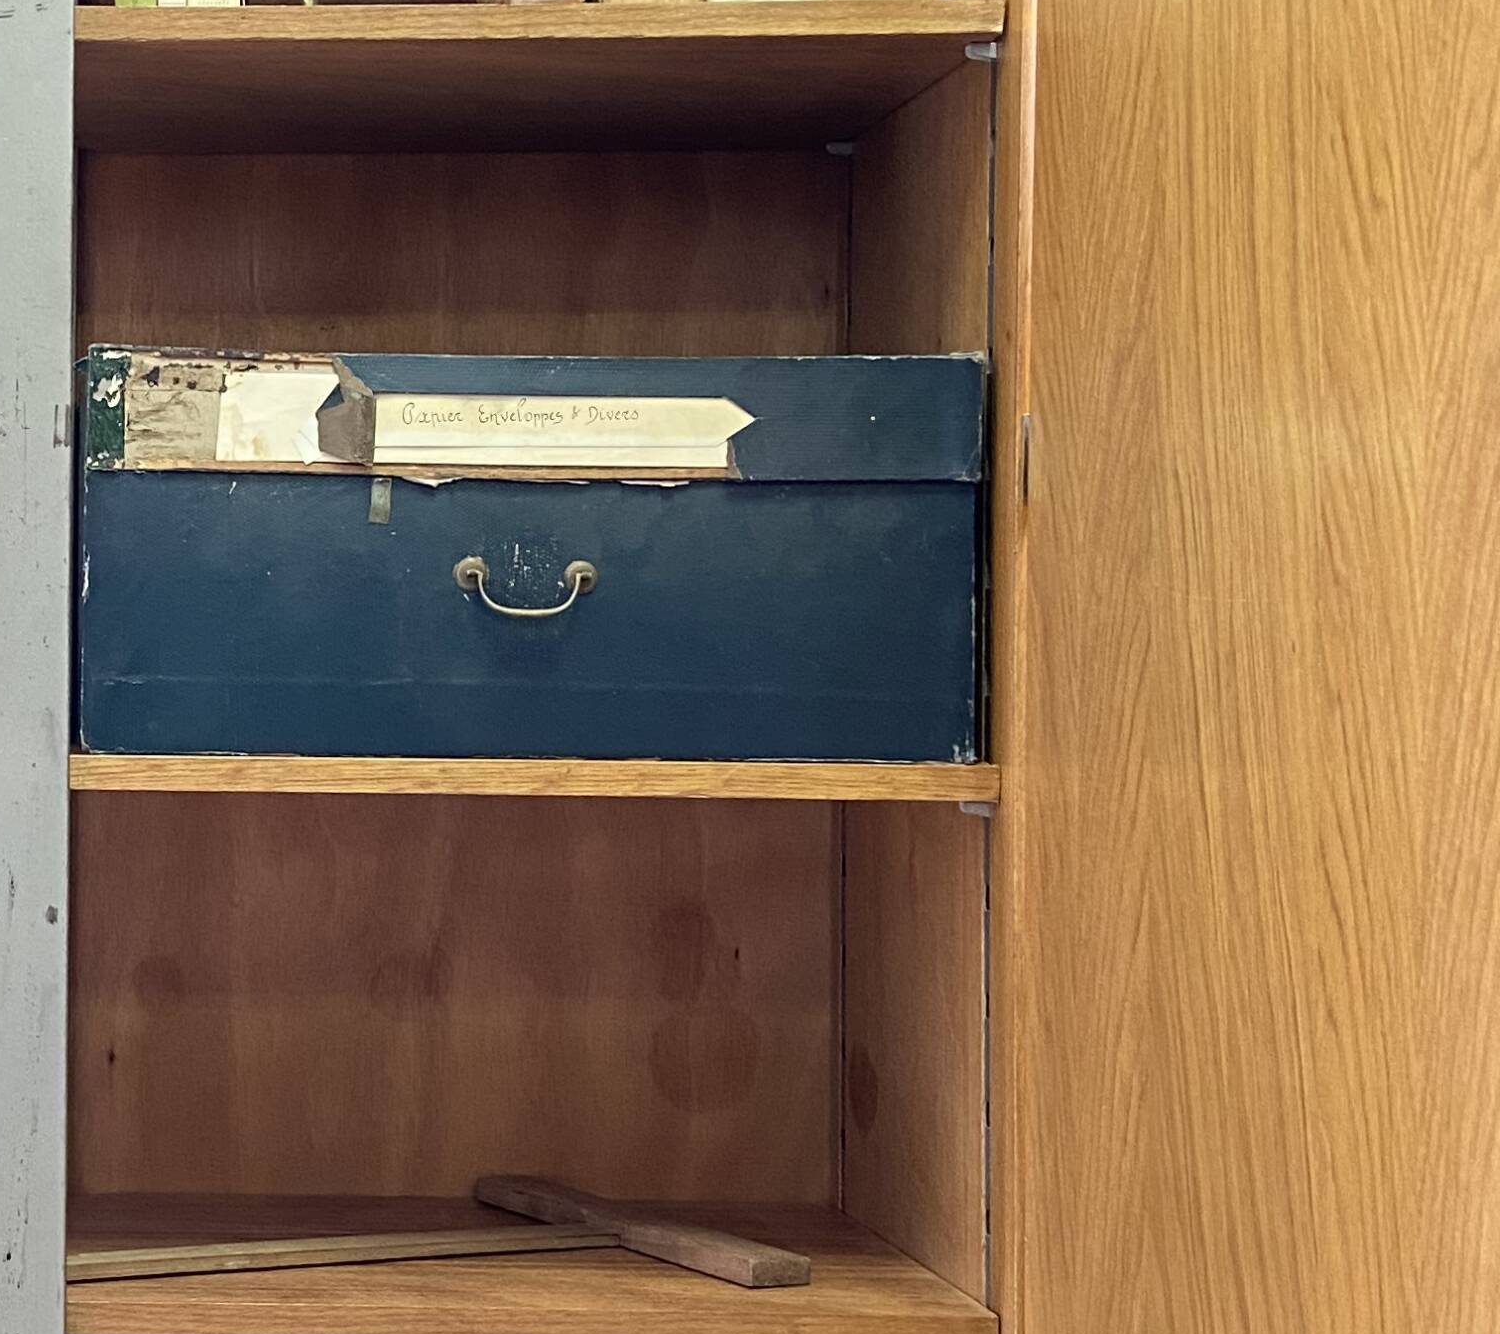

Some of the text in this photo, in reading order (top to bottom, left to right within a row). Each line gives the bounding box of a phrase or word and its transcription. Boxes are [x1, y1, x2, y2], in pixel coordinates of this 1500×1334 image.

[401, 401, 464, 428] Papier
[477, 397, 564, 427] Enveloppes
[585, 405, 639, 425] Divers
